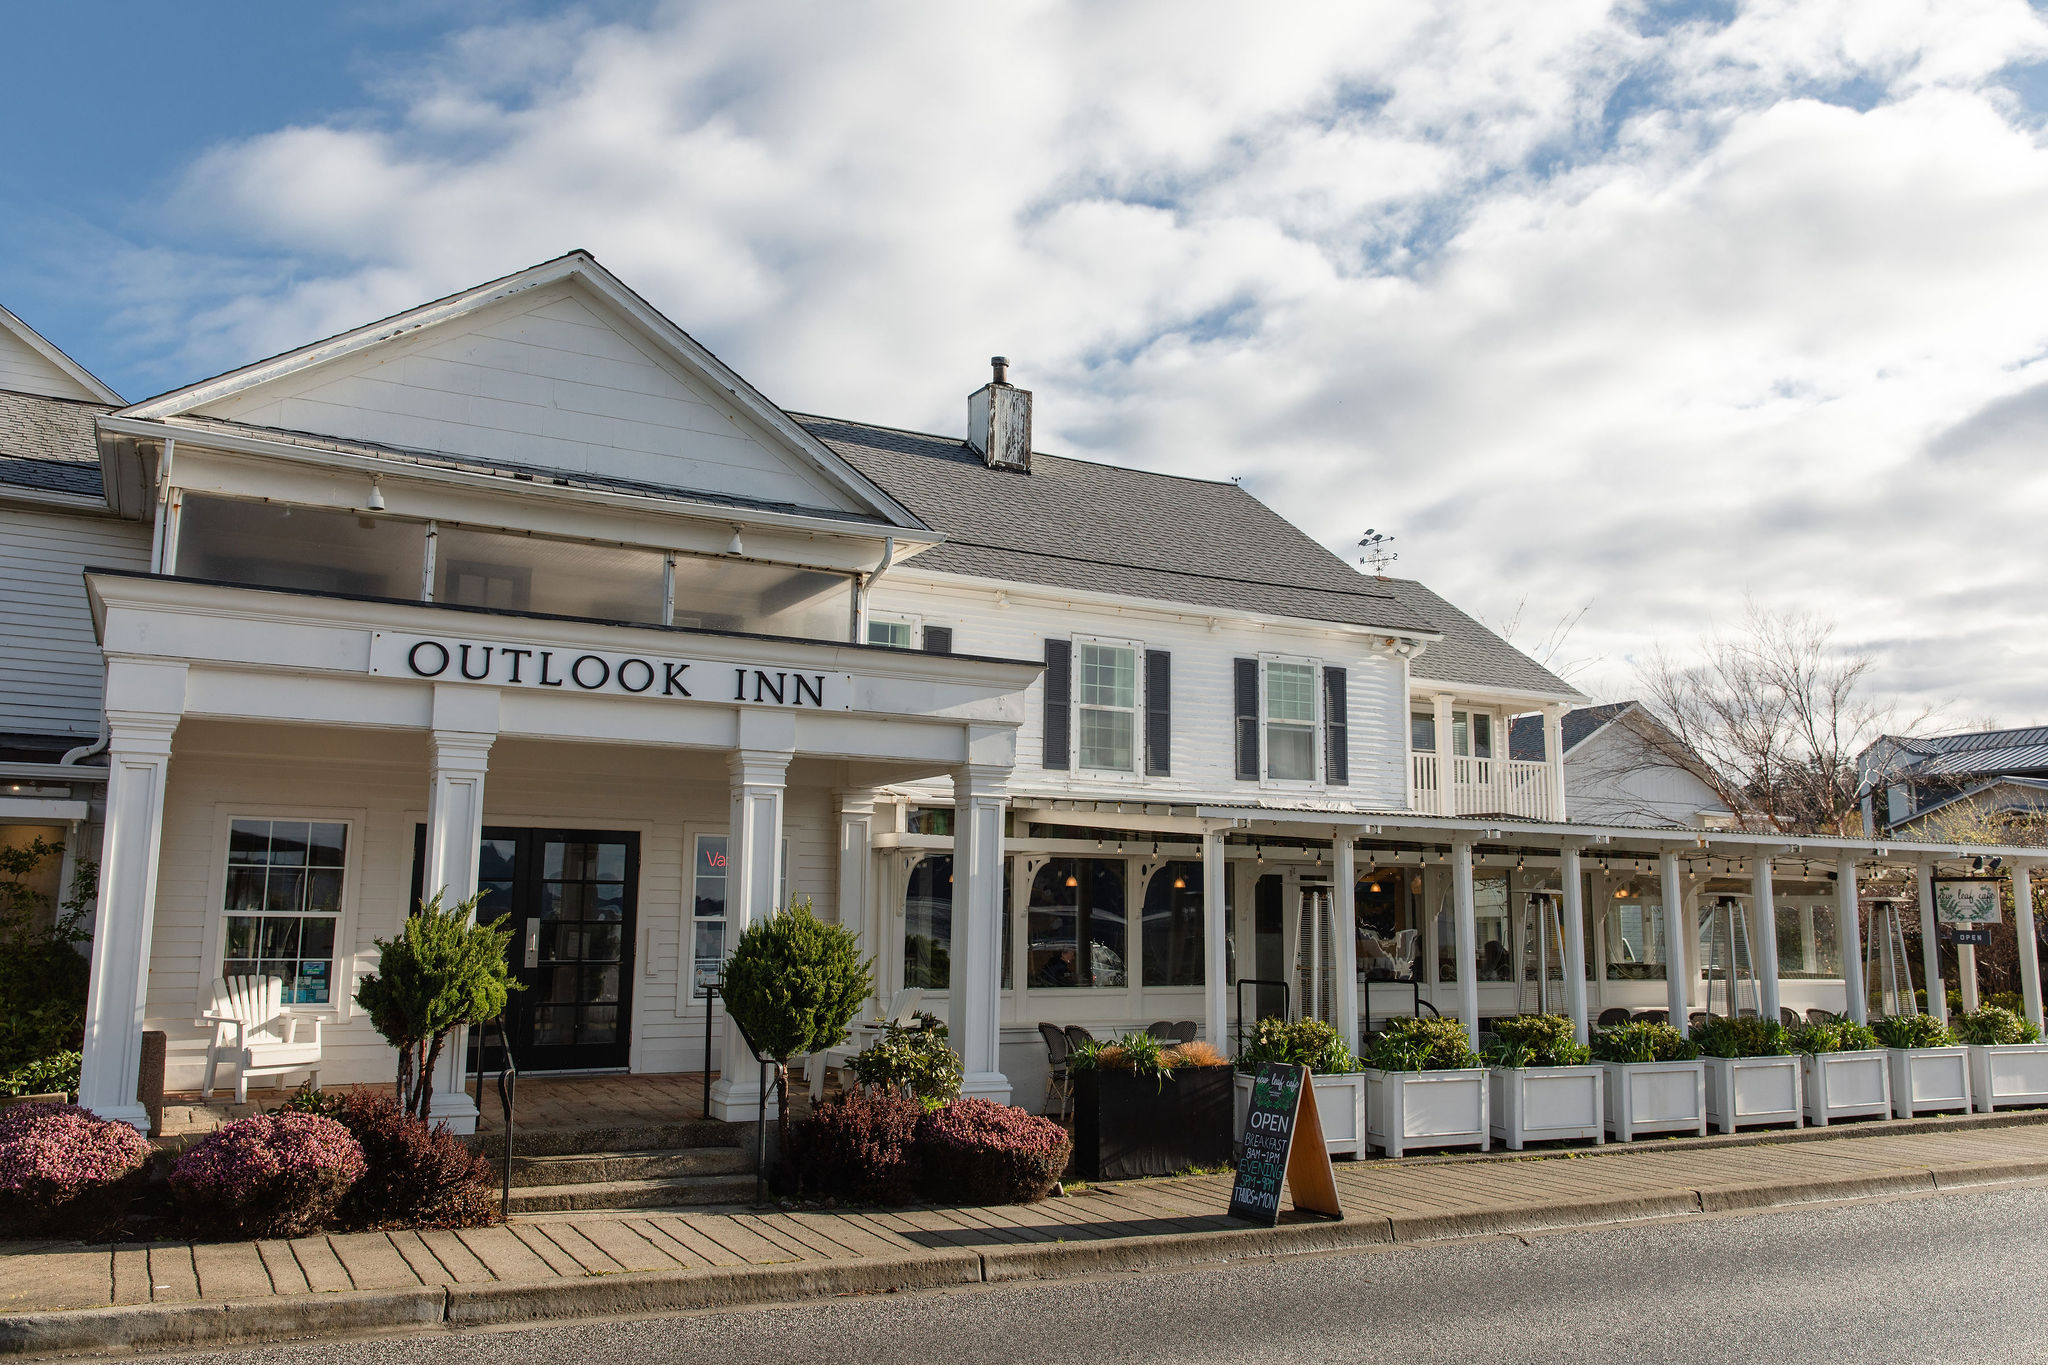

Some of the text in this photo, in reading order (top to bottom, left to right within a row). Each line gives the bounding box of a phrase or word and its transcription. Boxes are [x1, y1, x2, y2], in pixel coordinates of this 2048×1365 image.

[408, 640, 825, 707] OUTLOOK INN
[706, 850, 729, 867] Va
[1958, 889, 1973, 903] leaf
[1255, 1076, 1270, 1084] new
[1271, 1072, 1284, 1091] leaf
[1251, 1111, 1290, 1133] OPEN
[1244, 1132, 1288, 1152] BREAKFAST
[1239, 1158, 1283, 1180] EVENING
